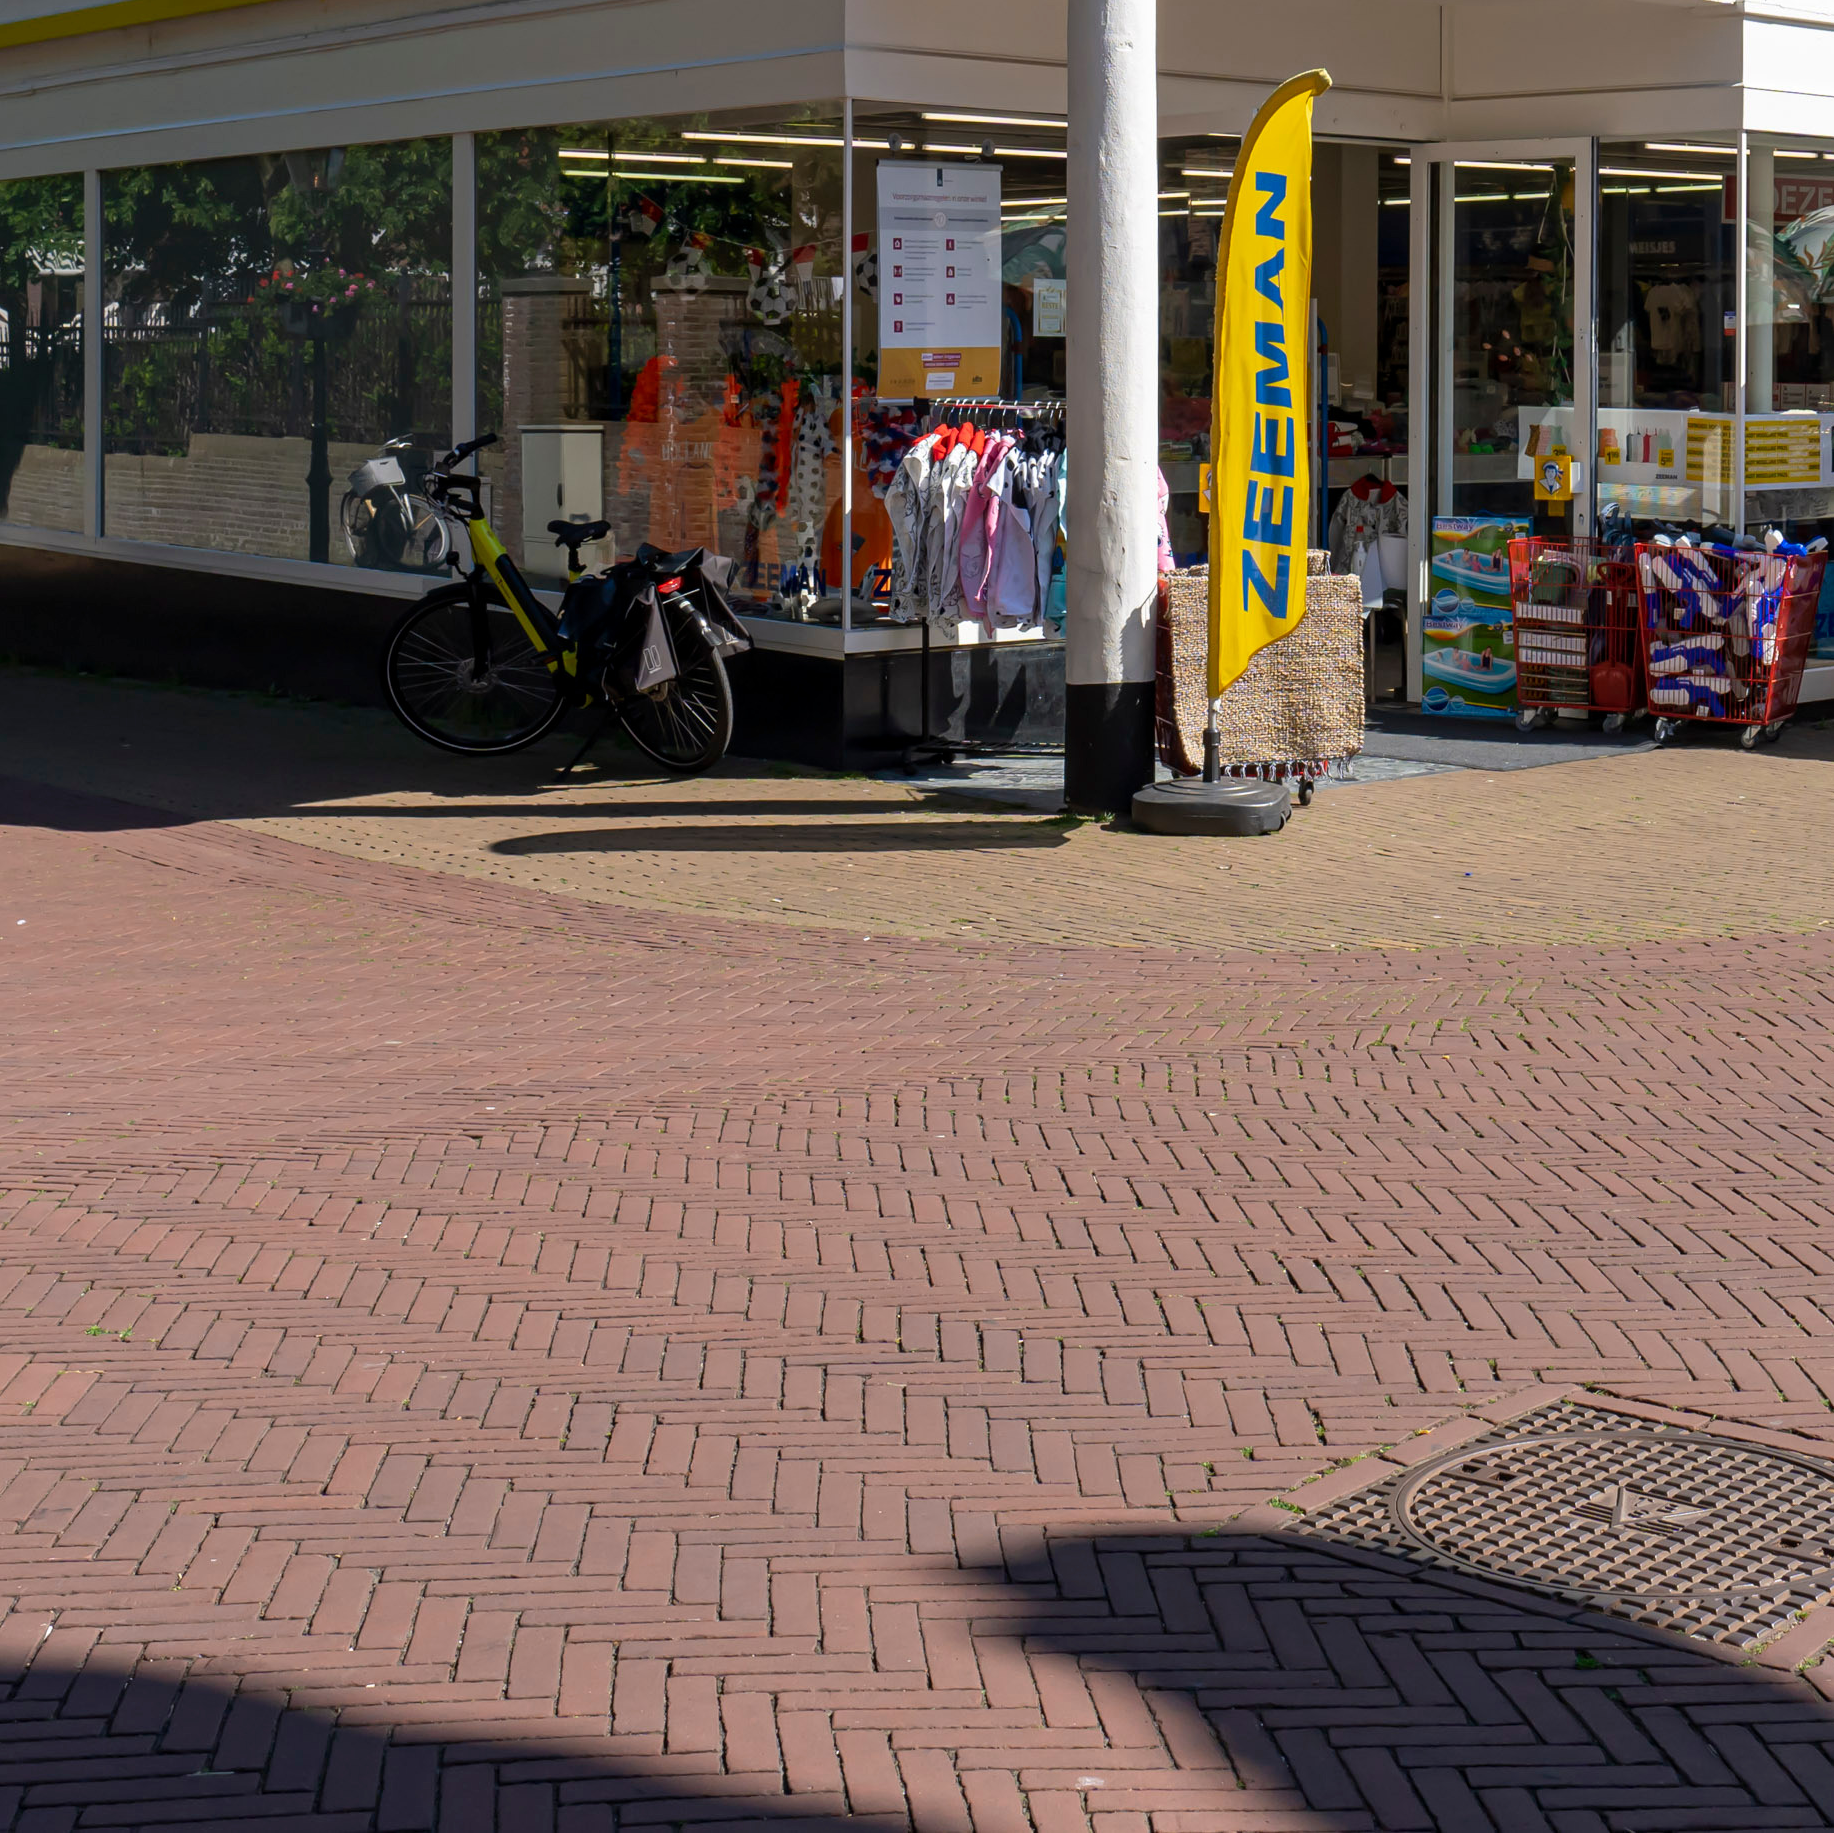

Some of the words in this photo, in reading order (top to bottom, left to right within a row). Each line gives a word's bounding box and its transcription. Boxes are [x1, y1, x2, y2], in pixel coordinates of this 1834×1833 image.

[1773, 184, 1834, 215] EZE
[1242, 171, 1295, 620] ZEEMAN
[1435, 520, 1475, 532] Bestway
[1426, 619, 1465, 630] Bestway
